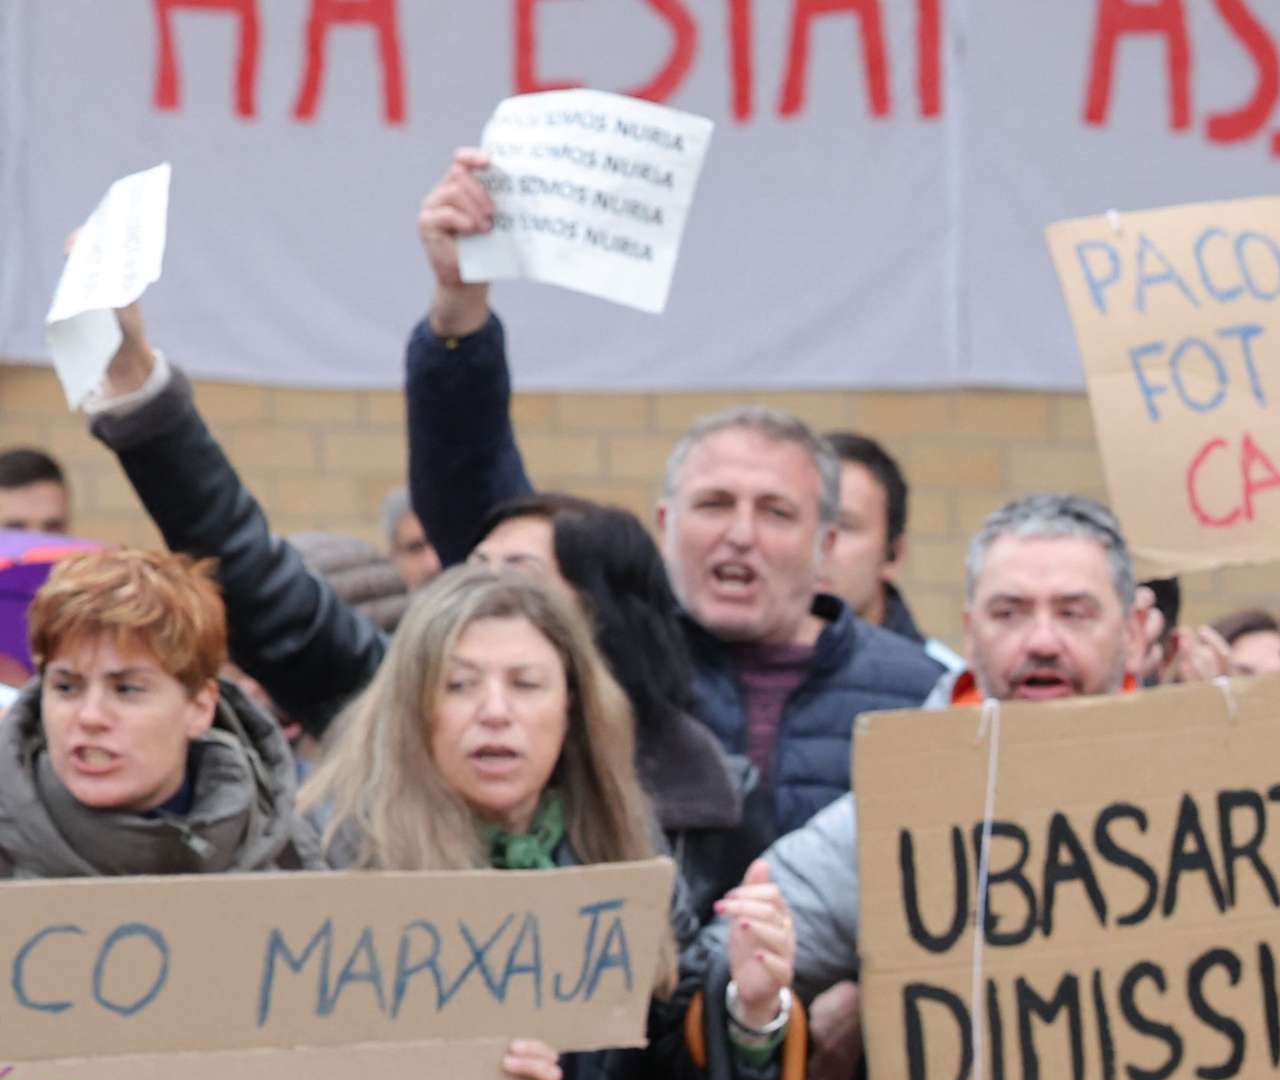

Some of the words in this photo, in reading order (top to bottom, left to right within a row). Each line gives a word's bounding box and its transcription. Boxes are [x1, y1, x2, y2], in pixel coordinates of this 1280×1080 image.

[615, 118, 685, 152] NURIA
[602, 155, 675, 189] NURIA
[594, 190, 664, 226] NURIA
[584, 226, 655, 262] NURIA
[1130, 323, 1267, 421] FOT
[11, 923, 170, 1018] CO
[256, 899, 635, 1027] MARXAJA
